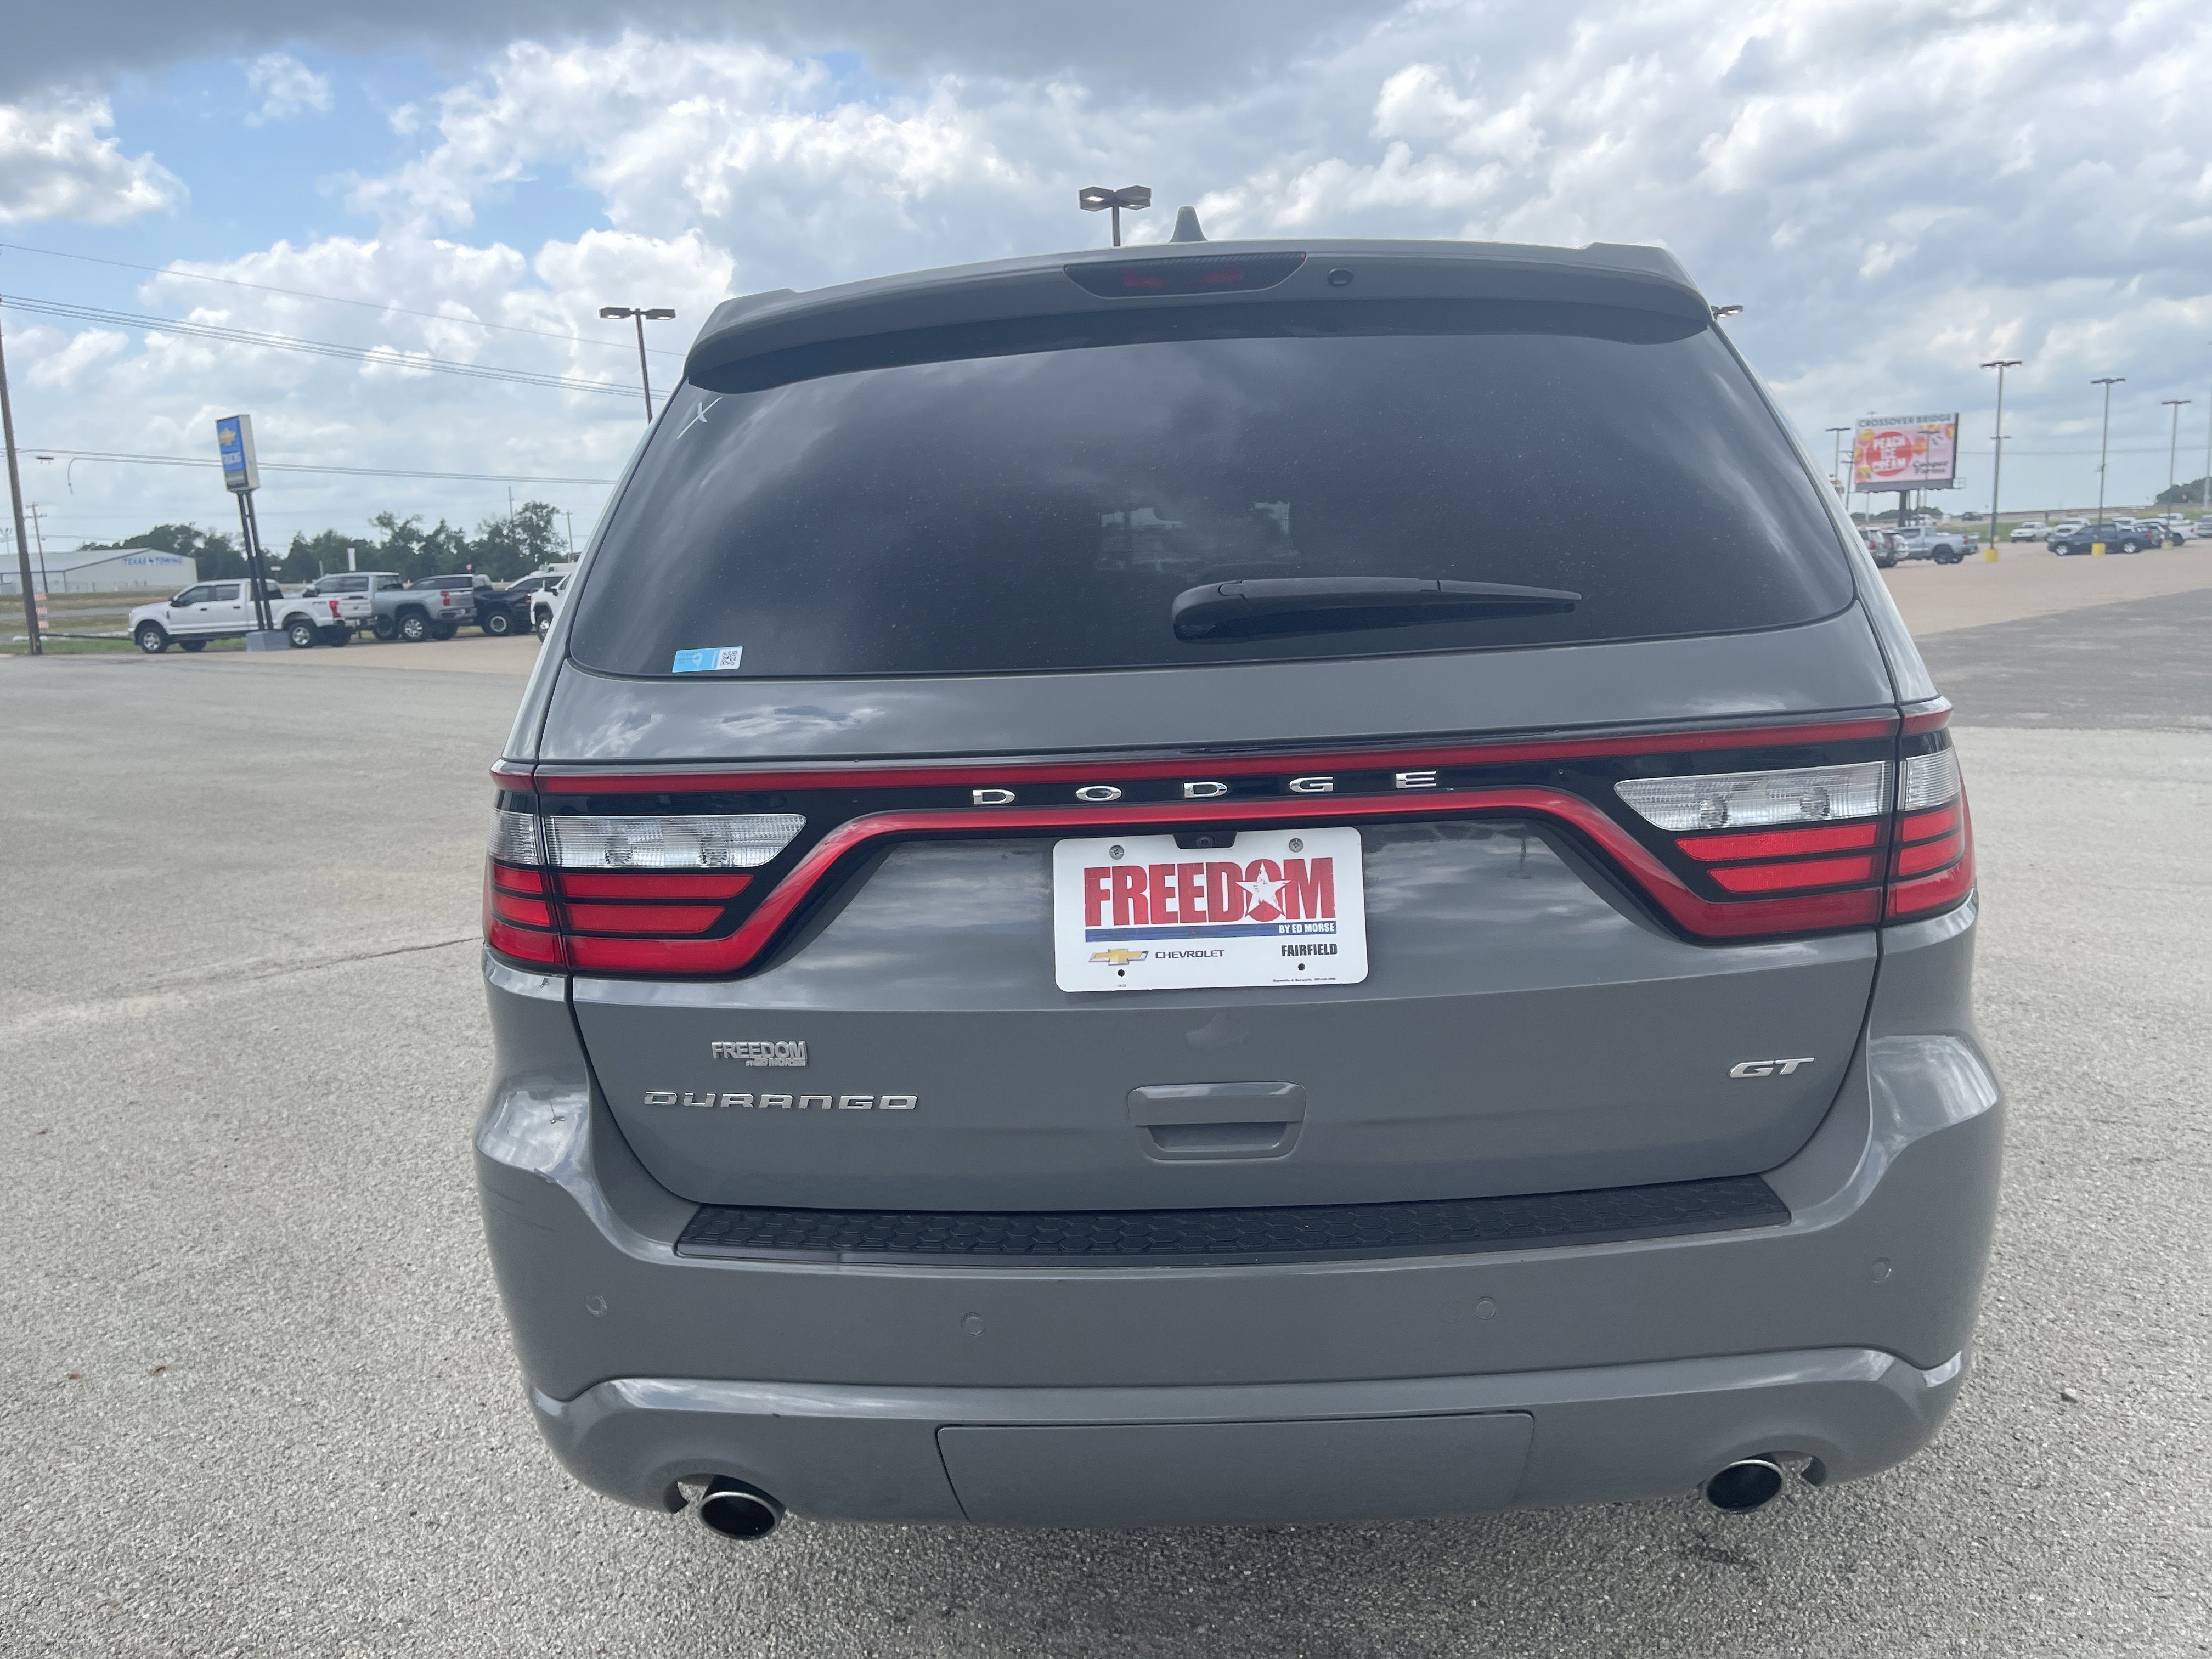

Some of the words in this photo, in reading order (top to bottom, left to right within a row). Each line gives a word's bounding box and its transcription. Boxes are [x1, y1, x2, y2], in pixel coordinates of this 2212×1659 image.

[1859, 416, 1915, 427] CROSSOVER
[1916, 413, 1951, 424] BRIDGE
[1873, 436, 1905, 449] PEACH
[1881, 447, 1897, 460] ICE
[1871, 458, 1906, 472] CREAM
[155, 557, 183, 566] TOWING
[973, 771, 1437, 805] DODGE
[1084, 857, 1335, 927] FREEDOM
[1279, 924, 1290, 934] BY
[1291, 924, 1302, 933] ED
[1304, 923, 1334, 933] MORSE
[1155, 950, 1224, 958] CHEVROLET
[1282, 944, 1338, 956] FAIRFIELD
[712, 1041, 806, 1059] FREEDOM
[754, 1058, 768, 1066] ED
[768, 1058, 806, 1066] MORSE
[1730, 1057, 1815, 1079] GT
[644, 1092, 918, 1109] DURANGO
